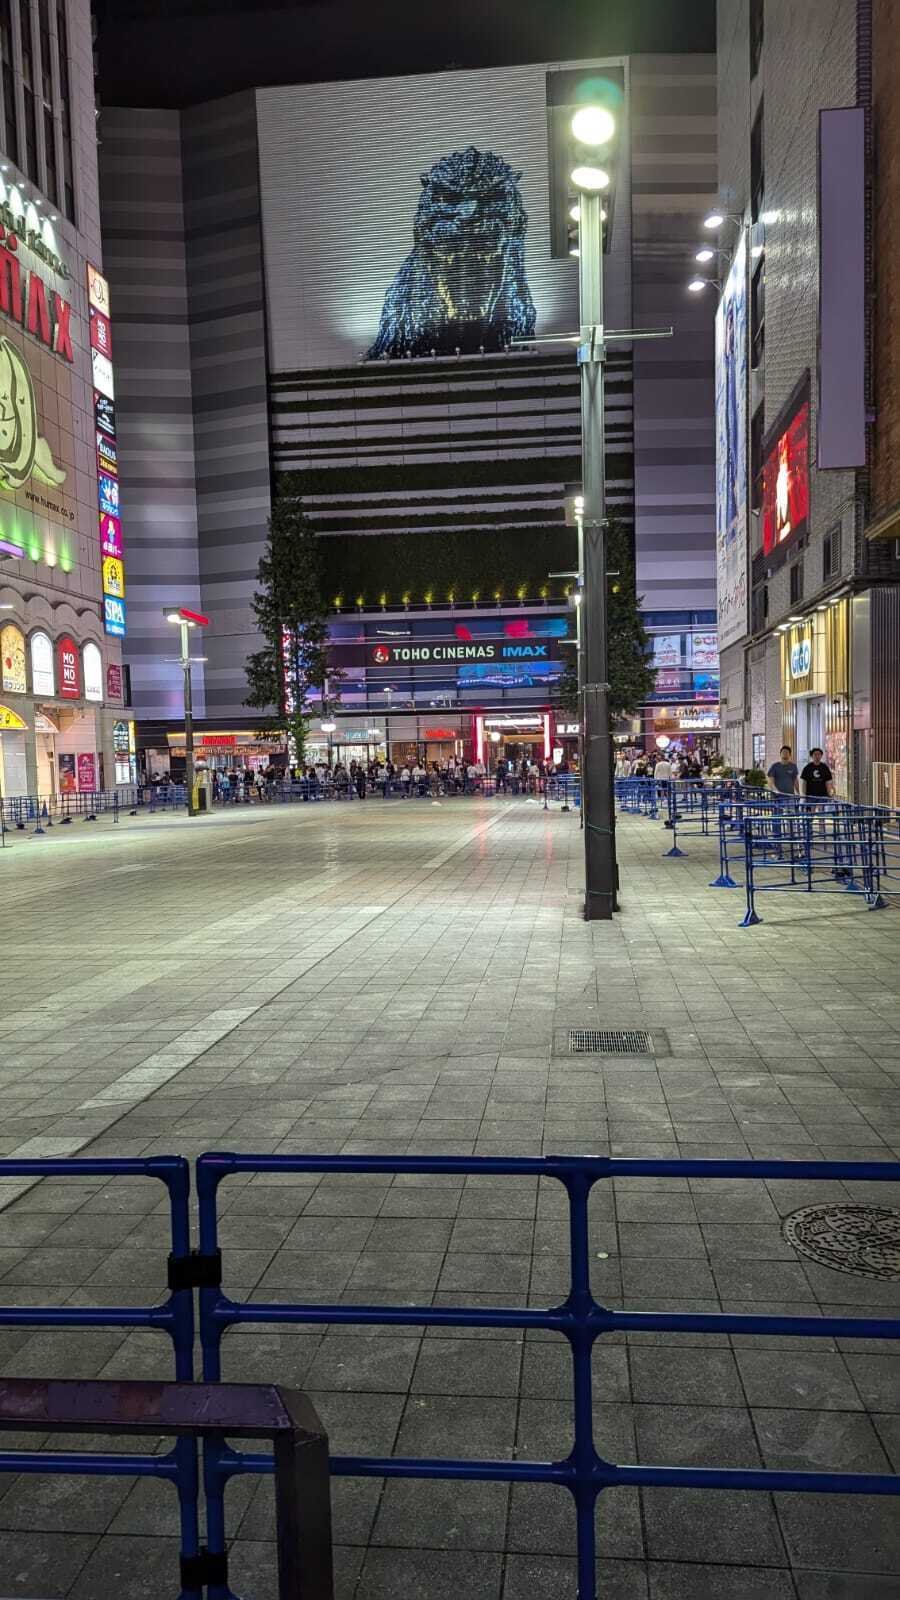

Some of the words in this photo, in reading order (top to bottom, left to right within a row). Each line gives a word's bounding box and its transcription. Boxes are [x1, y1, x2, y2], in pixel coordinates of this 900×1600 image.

[105, 598, 125, 624] SPA
[63, 652, 75, 665] MO
[393, 648, 430, 660] TOHO
[433, 645, 495, 660] CINEMAS
[502, 645, 547, 657] IMAX
[64, 667, 76, 681] MO
